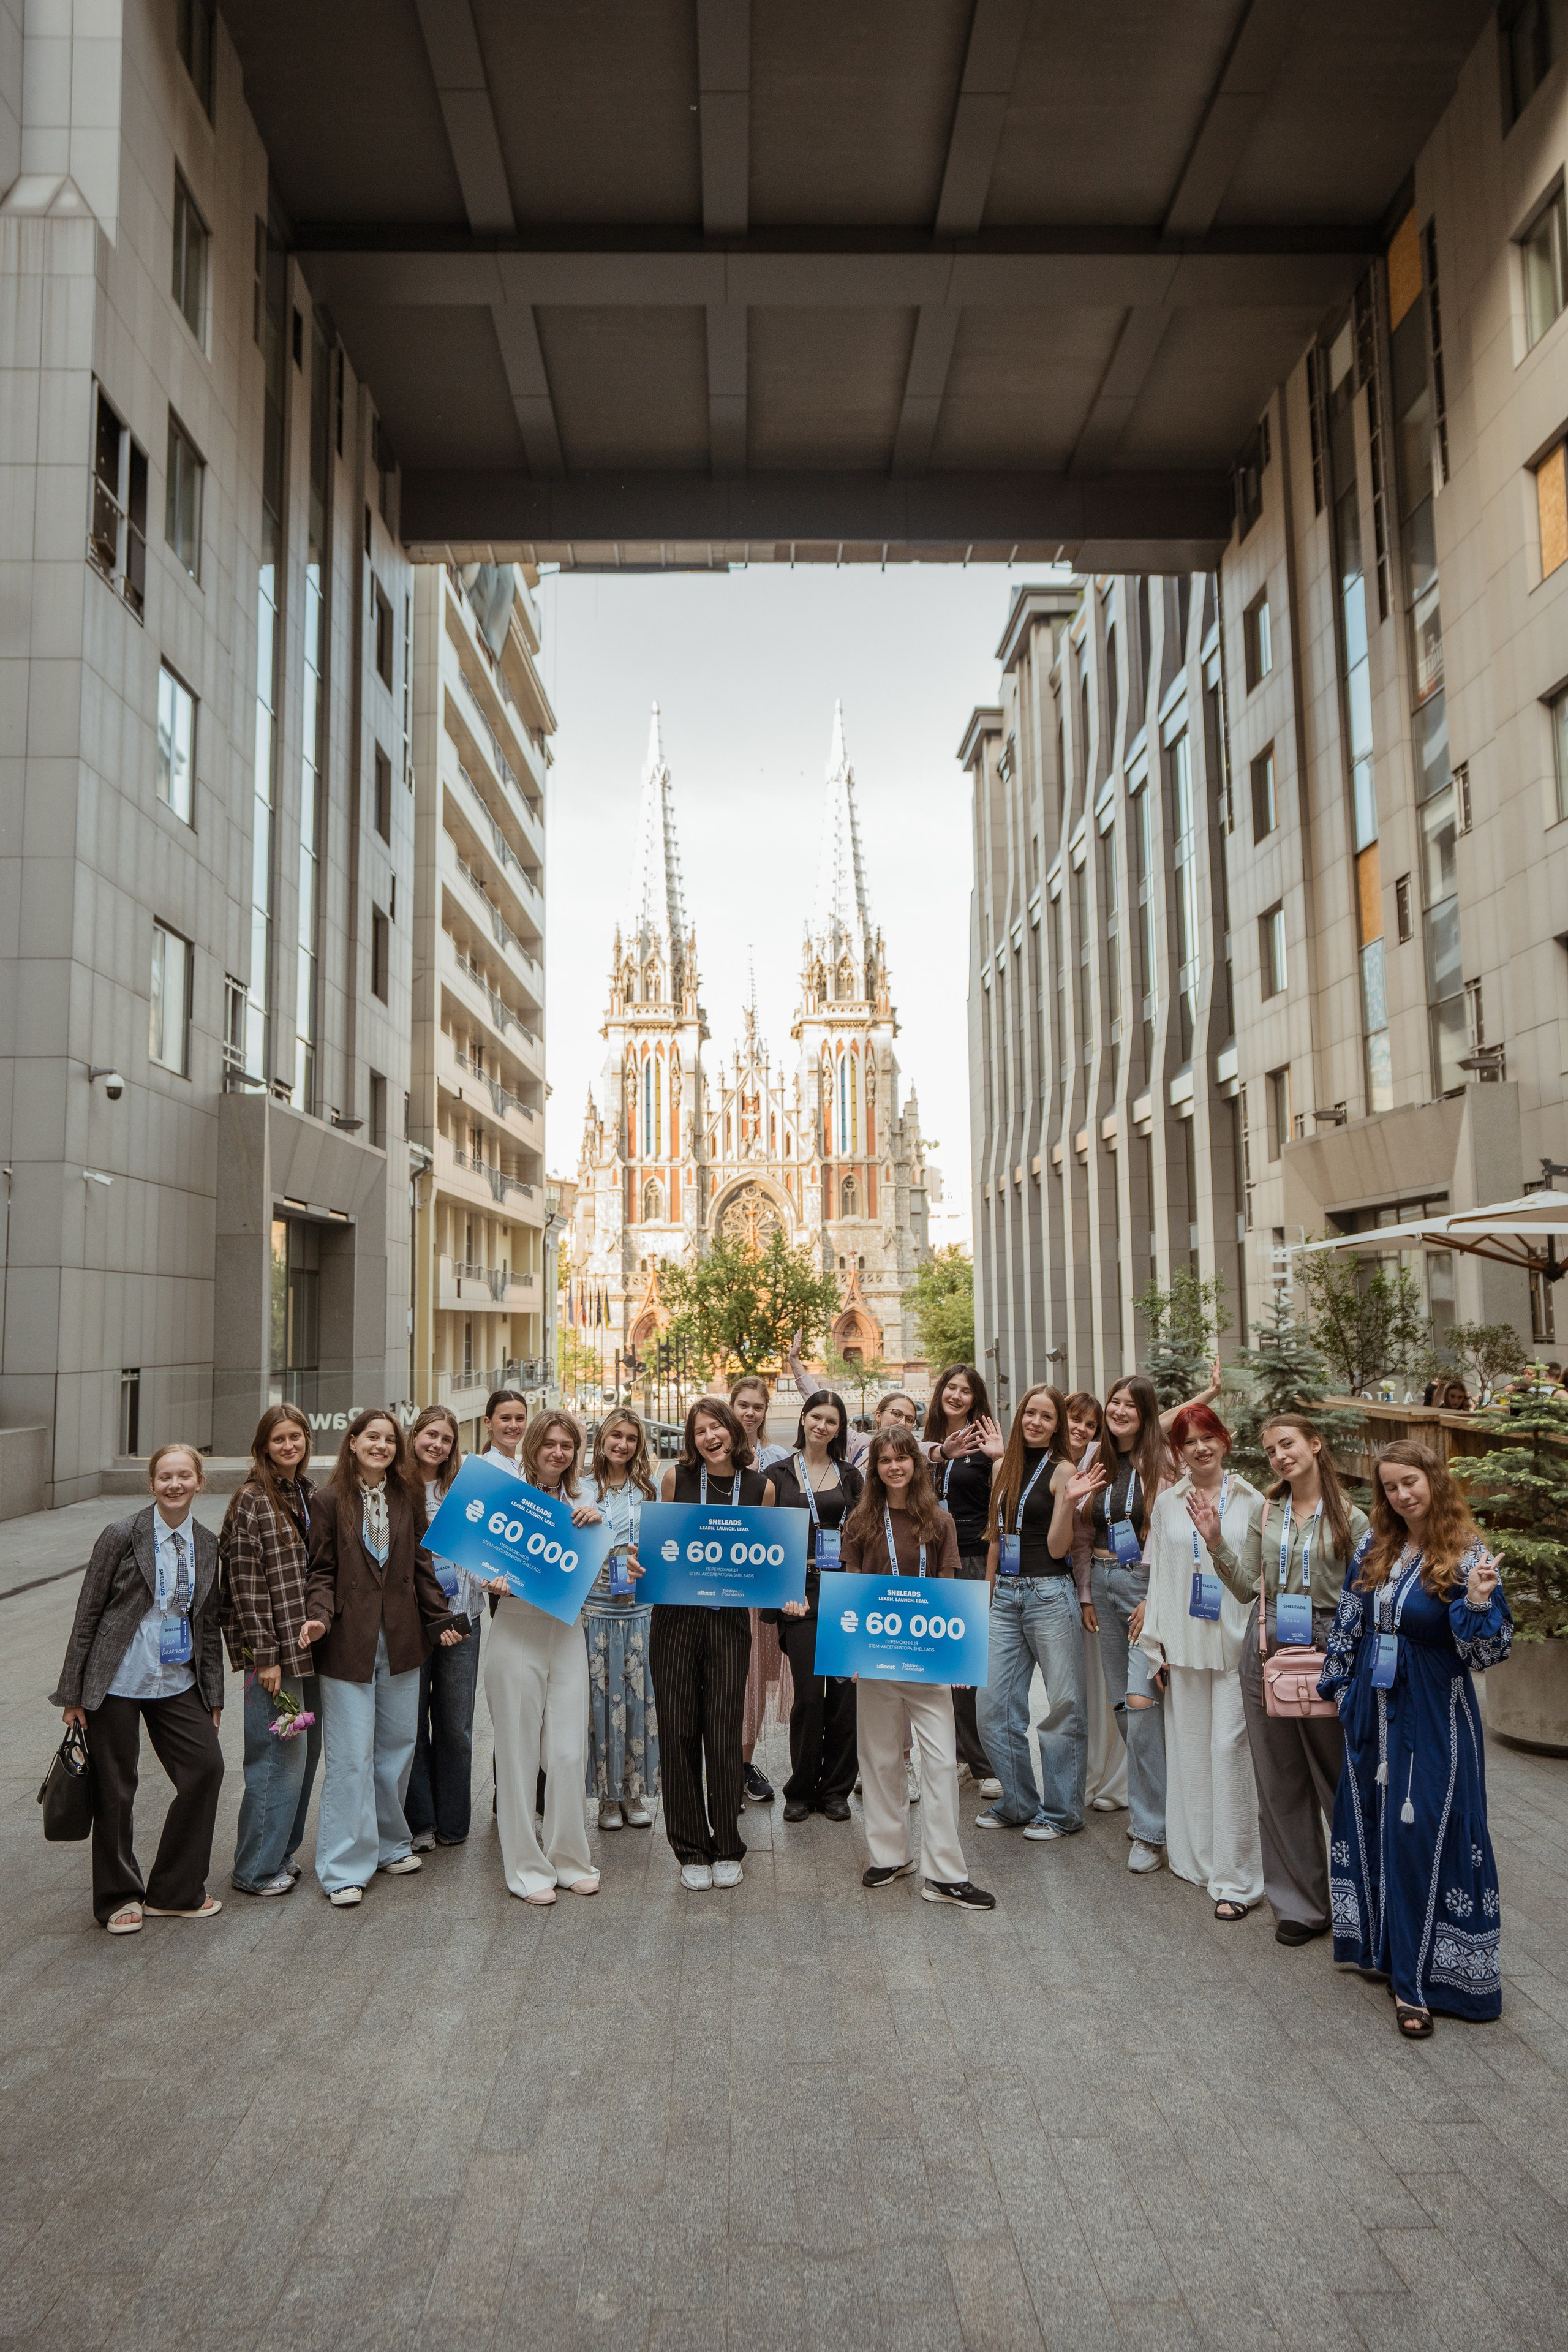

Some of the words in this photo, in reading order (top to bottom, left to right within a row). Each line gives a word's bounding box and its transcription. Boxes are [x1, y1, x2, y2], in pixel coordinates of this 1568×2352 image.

[1031, 1461, 1045, 1483] SHELEADS
[521, 1498, 552, 1518] SHELEADS
[807, 1488, 815, 1509] SHELEADS
[1018, 1493, 1027, 1517] SHELEADS
[511, 1500, 526, 1512] LEARN.
[525, 1508, 544, 1521] LAUNCH.
[543, 1517, 556, 1528] LEAD.
[488, 1512, 524, 1543] 60
[527, 1532, 578, 1572] 000
[499, 1542, 530, 1561] ПЕРЕМОЖНИЦЯ
[687, 1540, 723, 1564] 60
[730, 1542, 785, 1566] 000
[481, 1561, 499, 1574] uBoost
[506, 1570, 520, 1580] Tokarev
[521, 1561, 541, 1574] SHELEADS
[865, 1611, 902, 1636] 60
[910, 1615, 965, 1640] 000
